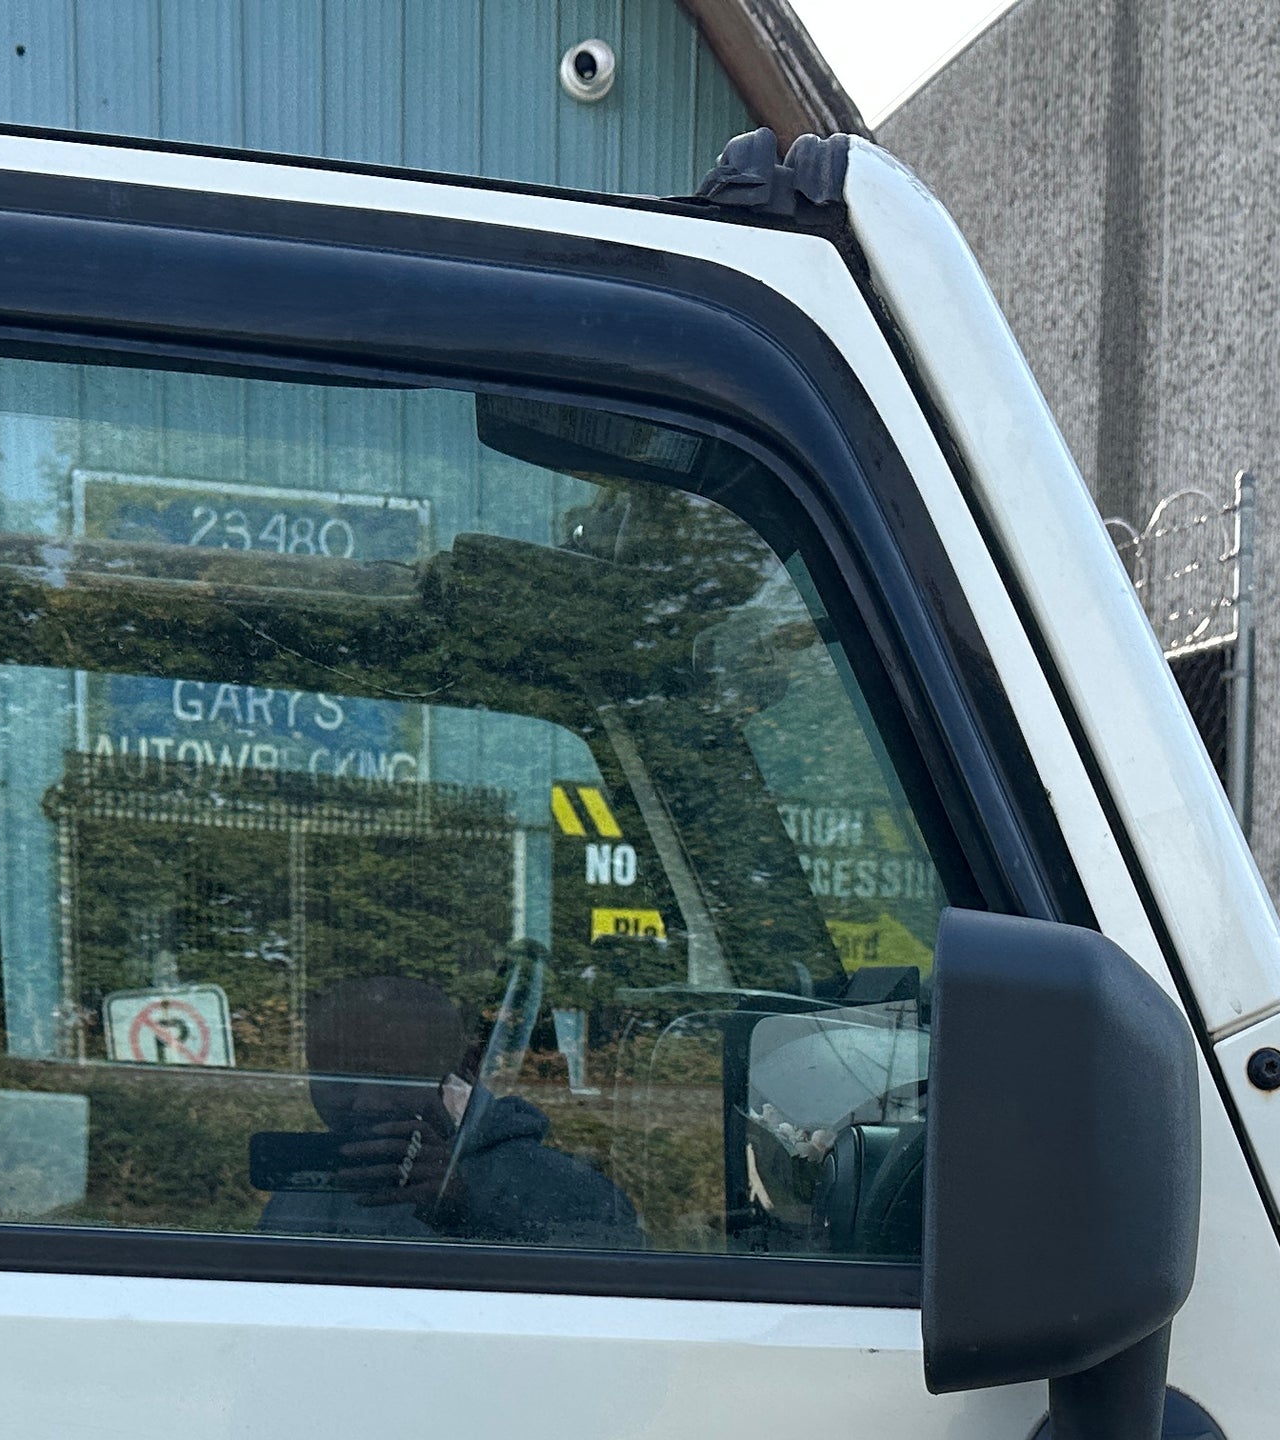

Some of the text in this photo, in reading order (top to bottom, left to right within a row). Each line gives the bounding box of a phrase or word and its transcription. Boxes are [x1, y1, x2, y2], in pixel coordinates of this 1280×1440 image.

[188, 504, 355, 560] 23480
[92, 733, 420, 787] AUTOWRCKING
[585, 844, 637, 886] NO
